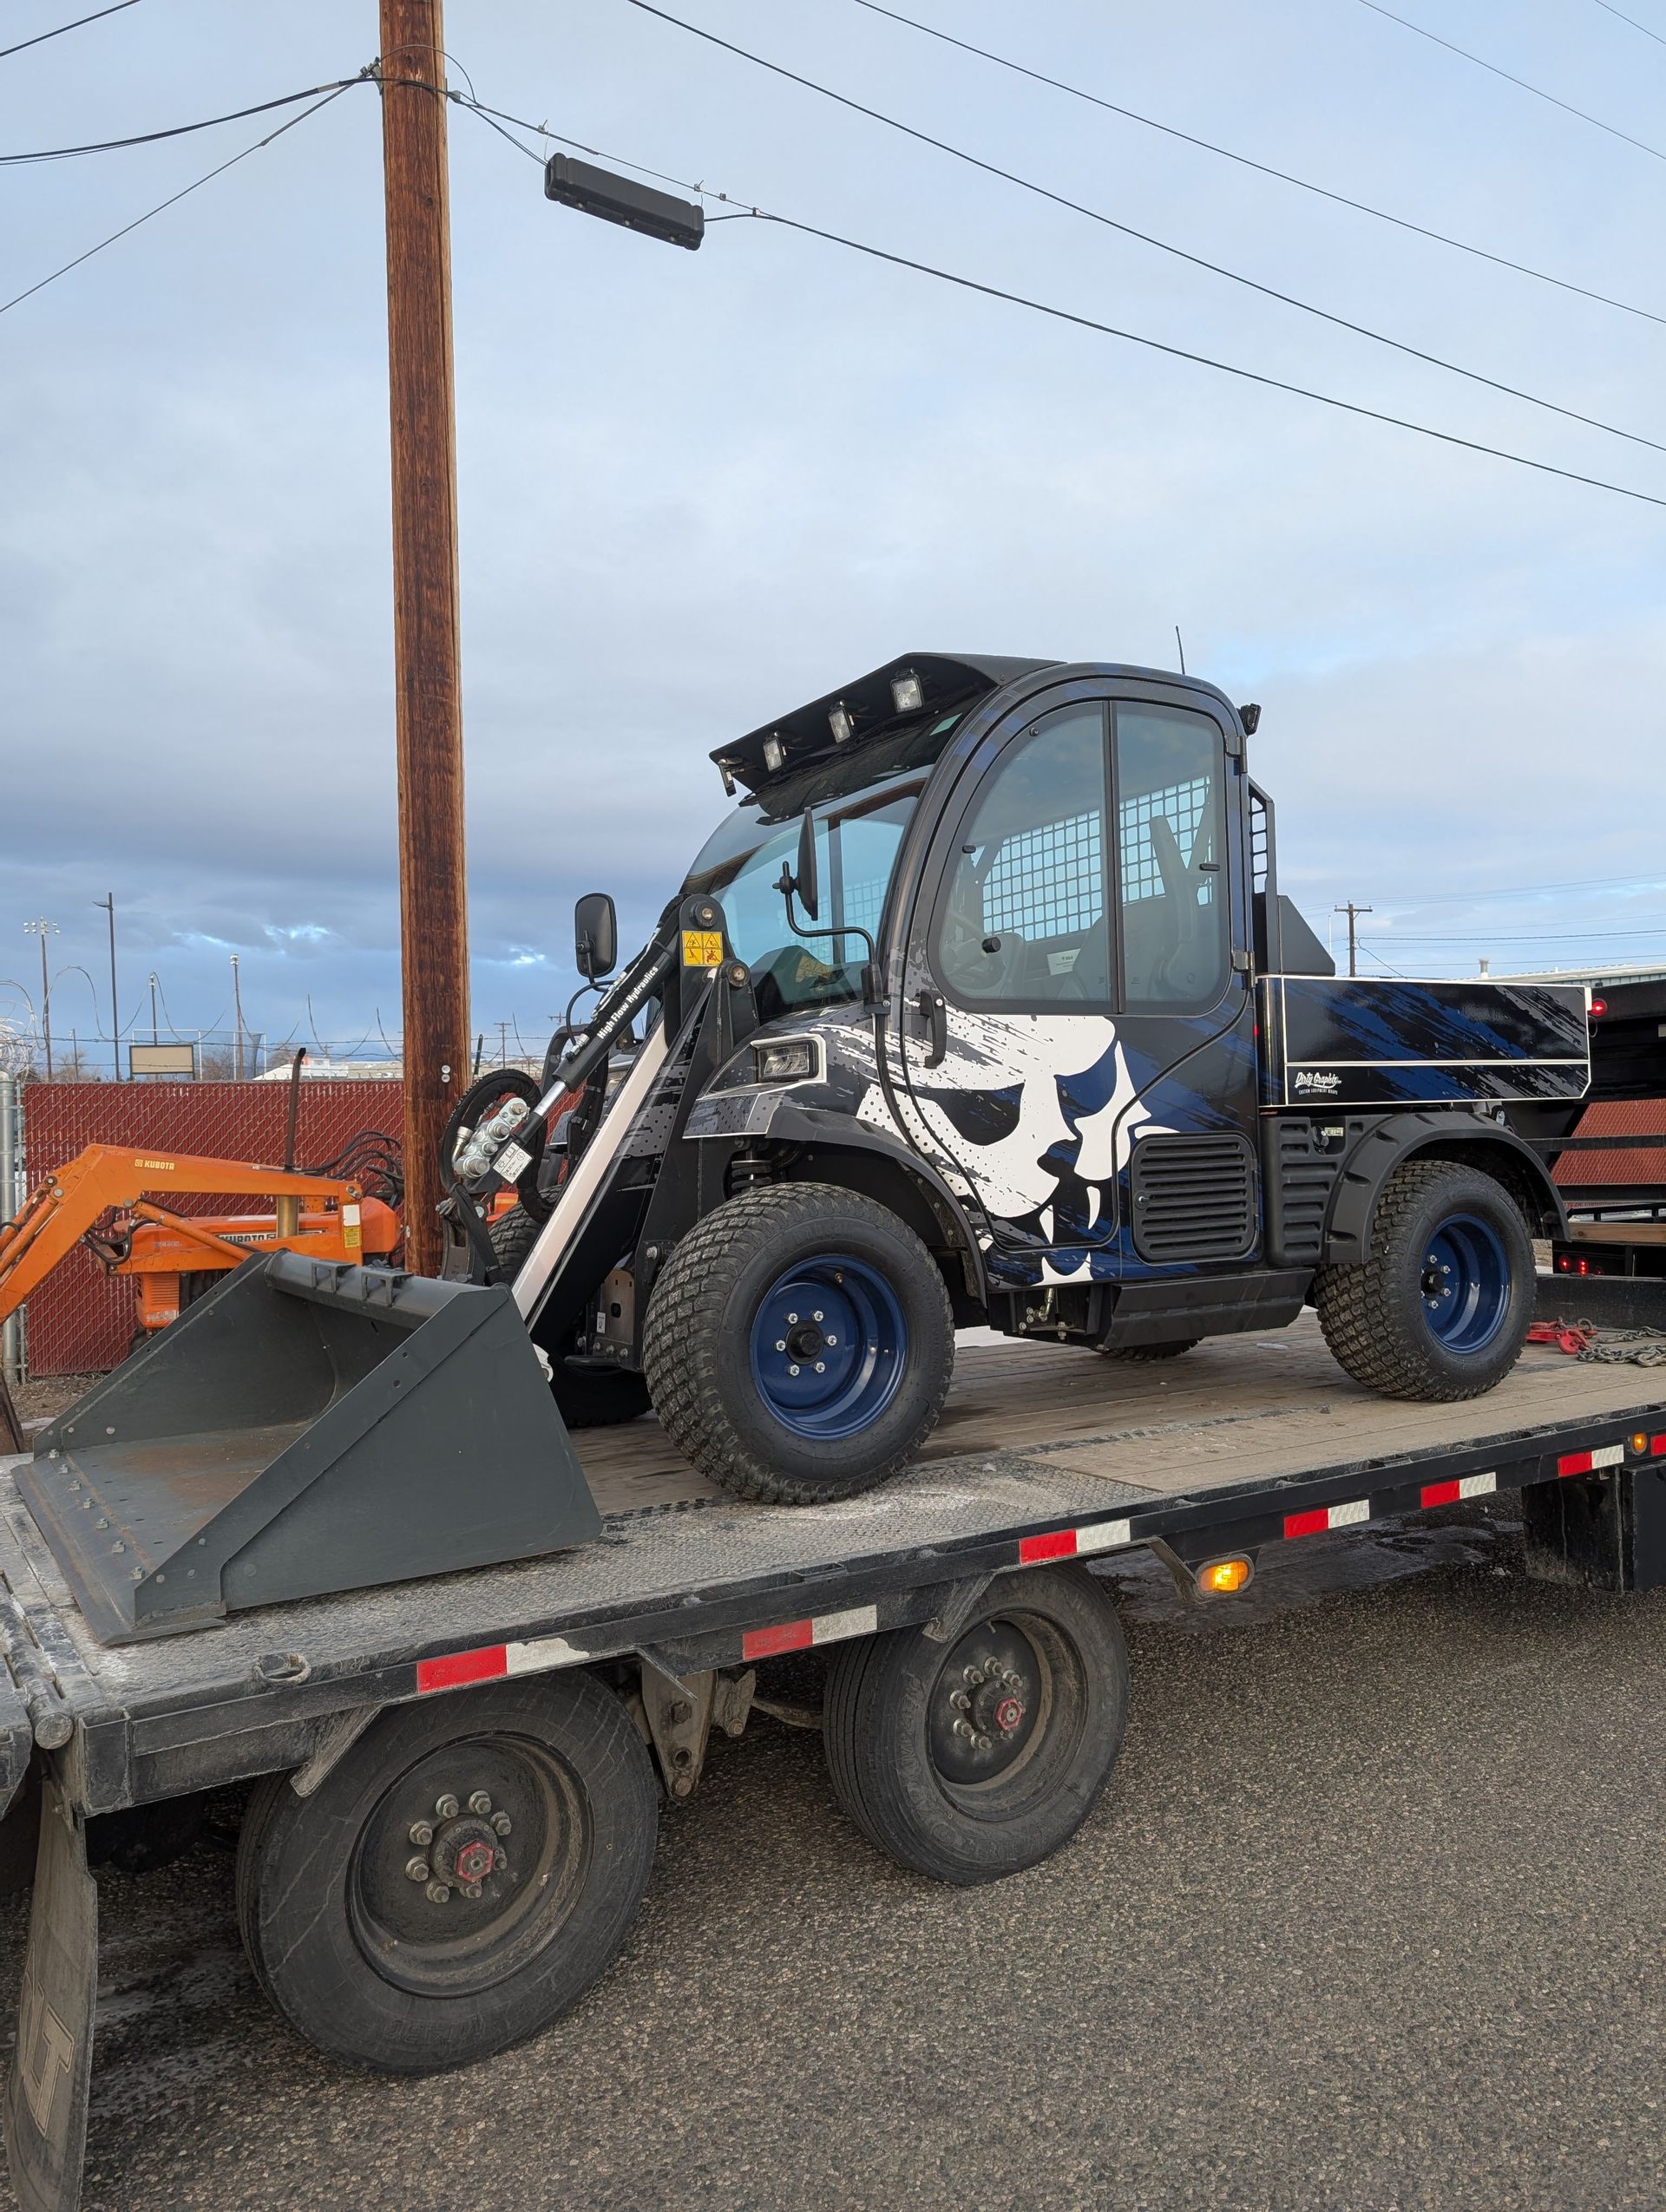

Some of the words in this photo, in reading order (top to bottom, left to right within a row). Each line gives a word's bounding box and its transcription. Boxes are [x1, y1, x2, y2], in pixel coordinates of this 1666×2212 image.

[596, 1019, 615, 1039] High
[610, 1002, 630, 1023] Flow
[626, 965, 659, 1004] Hydraulics
[1295, 1071, 1314, 1087] Dirty
[144, 1160, 175, 1171] KUBOTA
